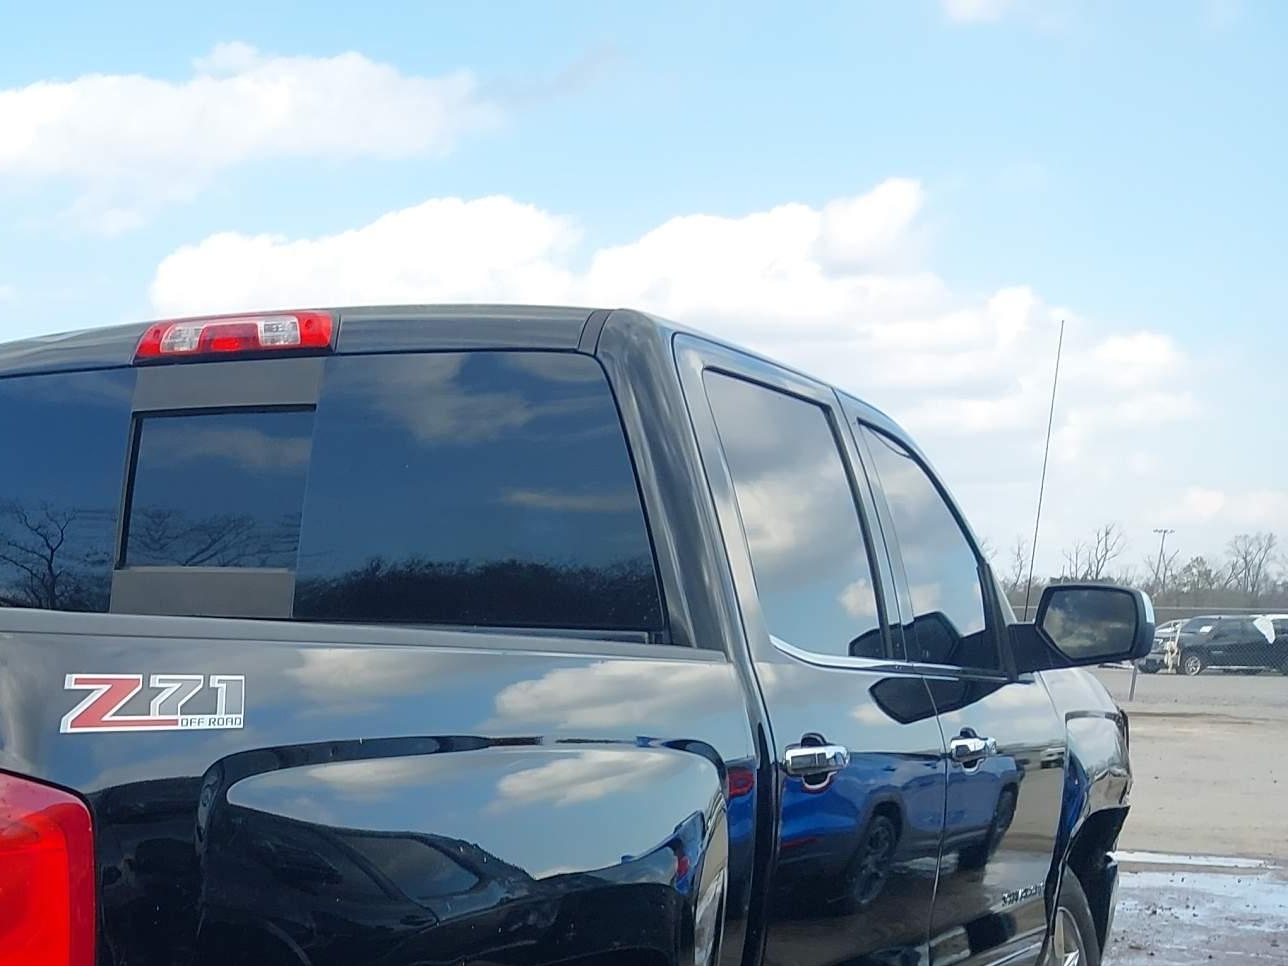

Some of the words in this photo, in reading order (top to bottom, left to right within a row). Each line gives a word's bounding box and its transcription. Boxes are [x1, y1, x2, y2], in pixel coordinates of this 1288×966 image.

[59, 674, 245, 733] Z71
[180, 717, 208, 728] OFF
[208, 716, 242, 727] ROAD
